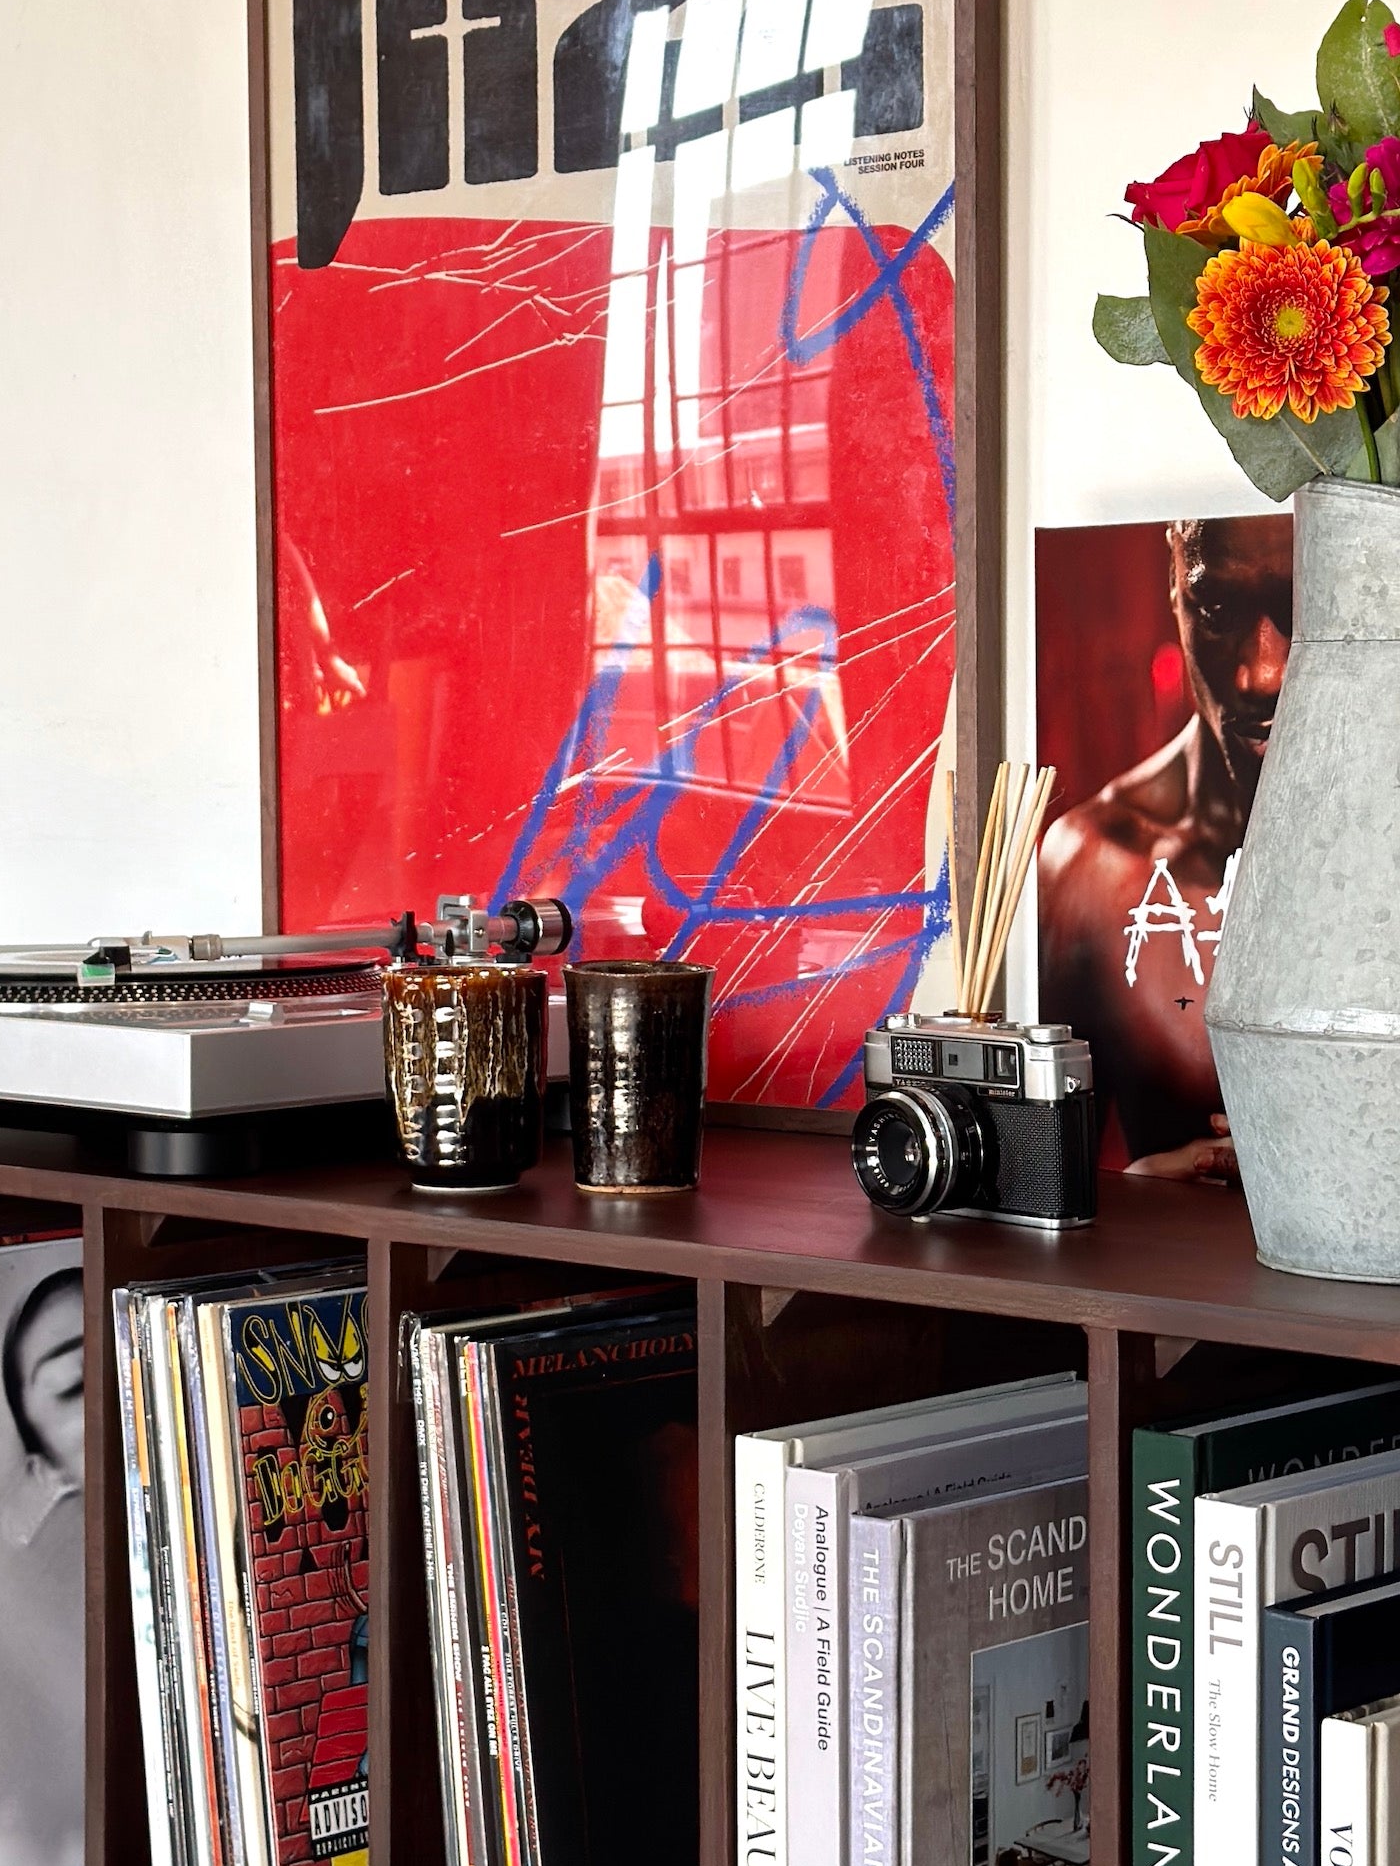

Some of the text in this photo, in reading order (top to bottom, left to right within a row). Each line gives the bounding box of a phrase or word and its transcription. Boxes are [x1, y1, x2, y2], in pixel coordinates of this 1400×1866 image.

[844, 149, 924, 166] LISTENING NOTES
[858, 159, 924, 175] SESSION FOUR
[411, 1344, 420, 1369] VMP
[417, 1419, 426, 1446] DMX
[420, 1478, 429, 1502] Dark
[515, 1393, 545, 1579] MY DEAR
[423, 1505, 431, 1526] And
[753, 1483, 766, 1585] CALDERONE
[791, 1504, 810, 1633] Deyan Sudjic
[813, 1505, 829, 1601] Analogue
[946, 1514, 1088, 1582] THE SCAND
[862, 1549, 880, 1604] THE
[988, 1566, 1074, 1622] HOME
[1208, 1540, 1244, 1656] STILL
[446, 1563, 455, 1588] THE
[452, 1643, 462, 1682] SHOW
[816, 1617, 830, 1632] A
[482, 1655, 492, 1674] PAC
[484, 1676, 493, 1695] ALL
[745, 1626, 776, 1738] LIVE
[817, 1638, 831, 1686] Field
[506, 1675, 516, 1711] FOREST
[1282, 1646, 1300, 1744] GRAND
[487, 1723, 497, 1739] ON
[489, 1740, 498, 1756] ME
[817, 1692, 832, 1752] Guide
[1208, 1679, 1222, 1802] The Slow Home
[1282, 1747, 1300, 1854] DESIGNS
